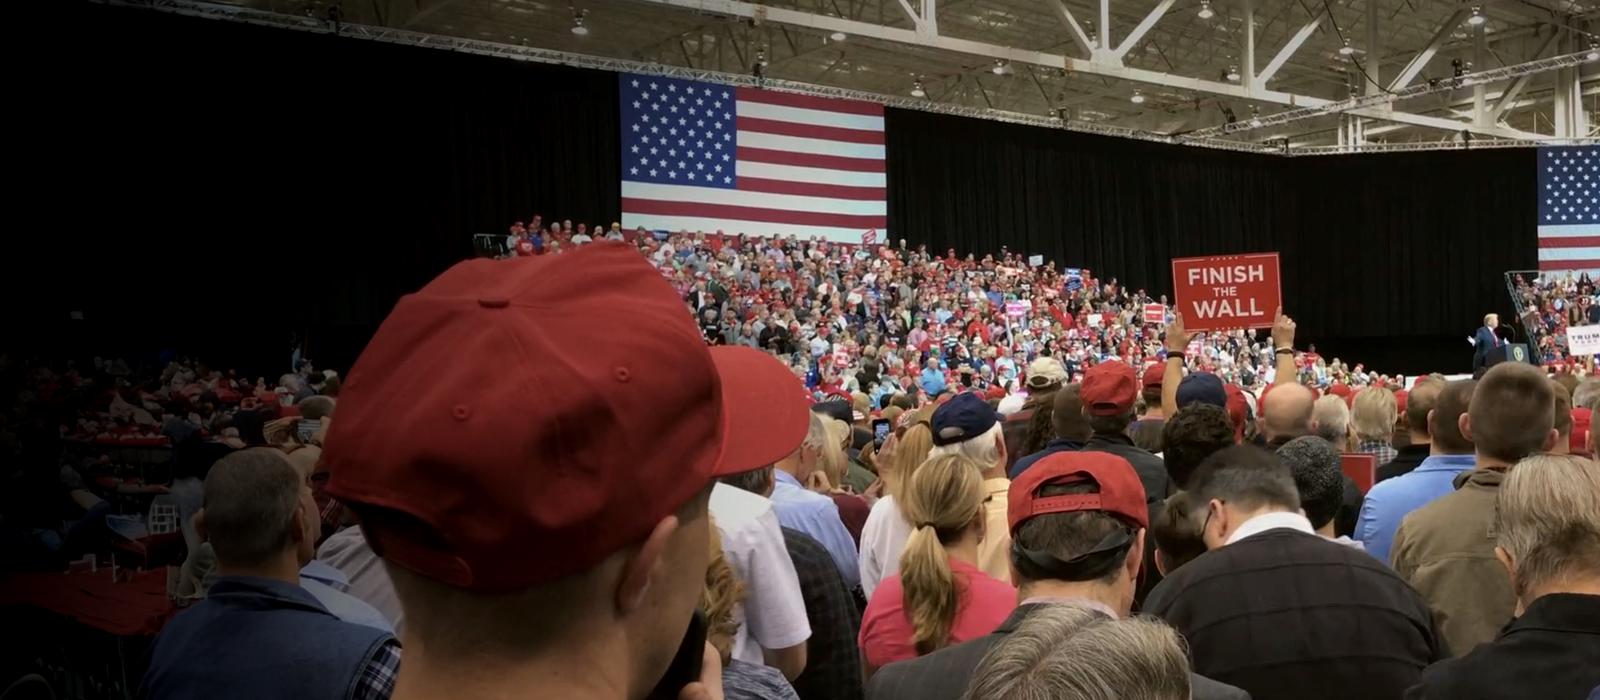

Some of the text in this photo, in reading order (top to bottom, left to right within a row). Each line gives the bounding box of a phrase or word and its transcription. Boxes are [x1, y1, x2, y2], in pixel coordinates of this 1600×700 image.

[1188, 264, 1264, 285] FINISH
[1213, 286, 1237, 297] THE
[1192, 297, 1264, 319] WALL
